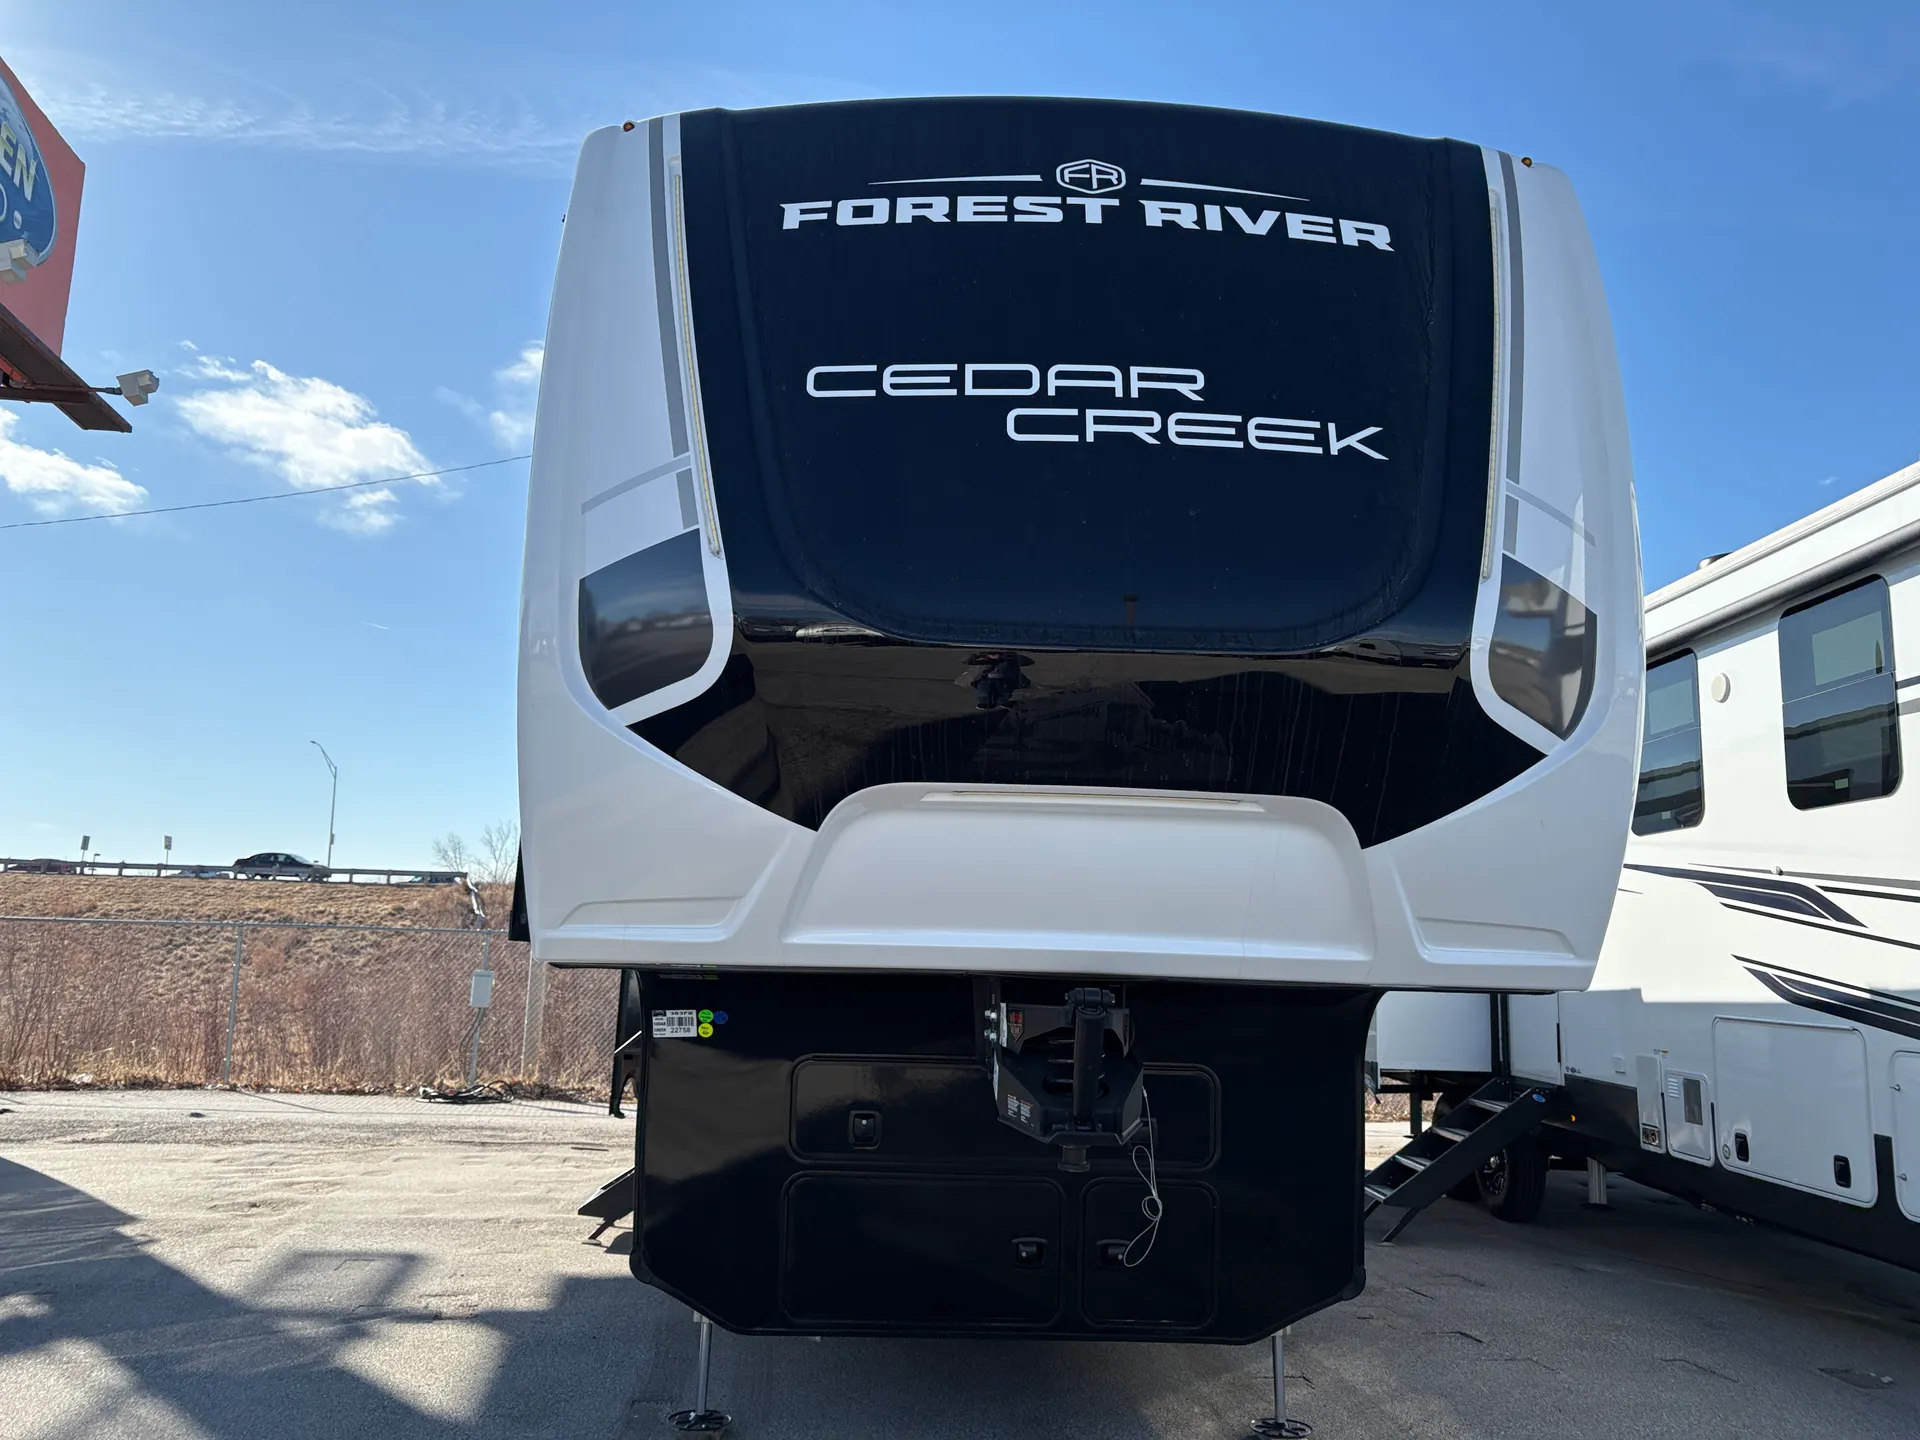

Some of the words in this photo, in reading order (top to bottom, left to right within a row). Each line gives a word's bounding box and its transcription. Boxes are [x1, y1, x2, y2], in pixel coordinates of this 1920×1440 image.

[780, 195, 1120, 230] FOREST
[1138, 199, 1395, 252] RIVER
[806, 363, 1205, 402] CEDAR
[1006, 407, 1390, 461] CREEK
